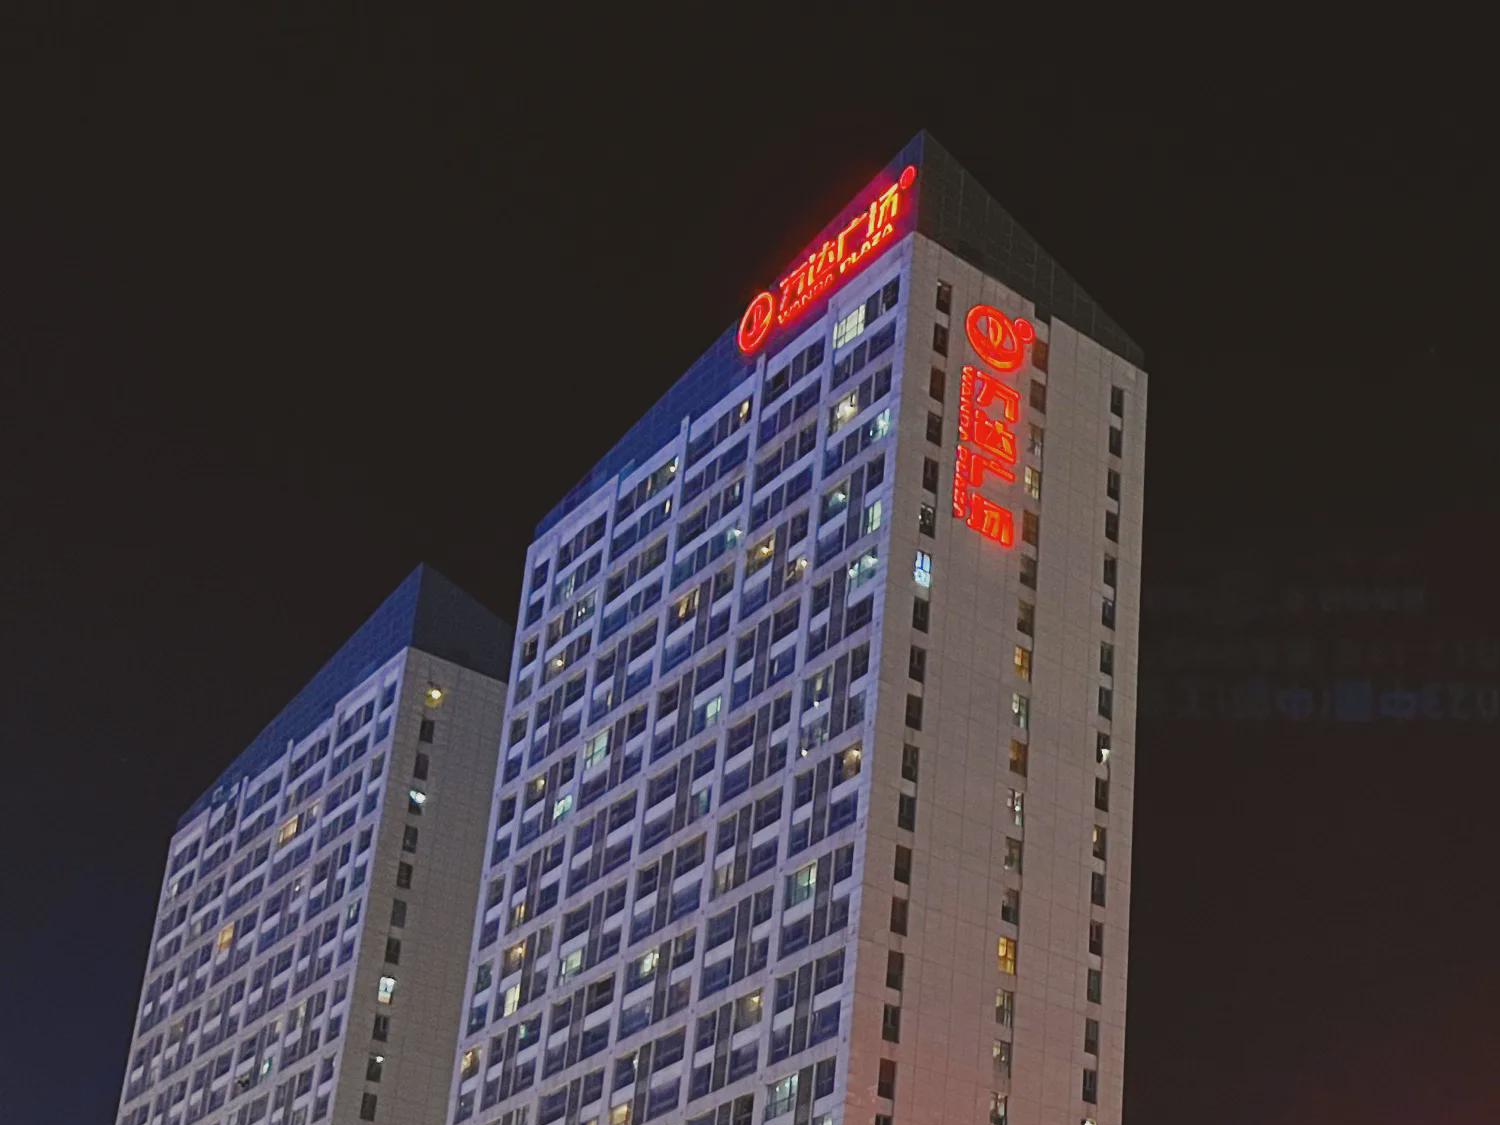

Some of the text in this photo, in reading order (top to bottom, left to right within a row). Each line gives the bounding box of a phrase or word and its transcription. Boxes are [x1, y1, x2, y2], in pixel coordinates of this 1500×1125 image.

[779, 183, 899, 312] 万达广场
[839, 222, 894, 275] PLAZA
[966, 369, 1020, 548] 万达广场
